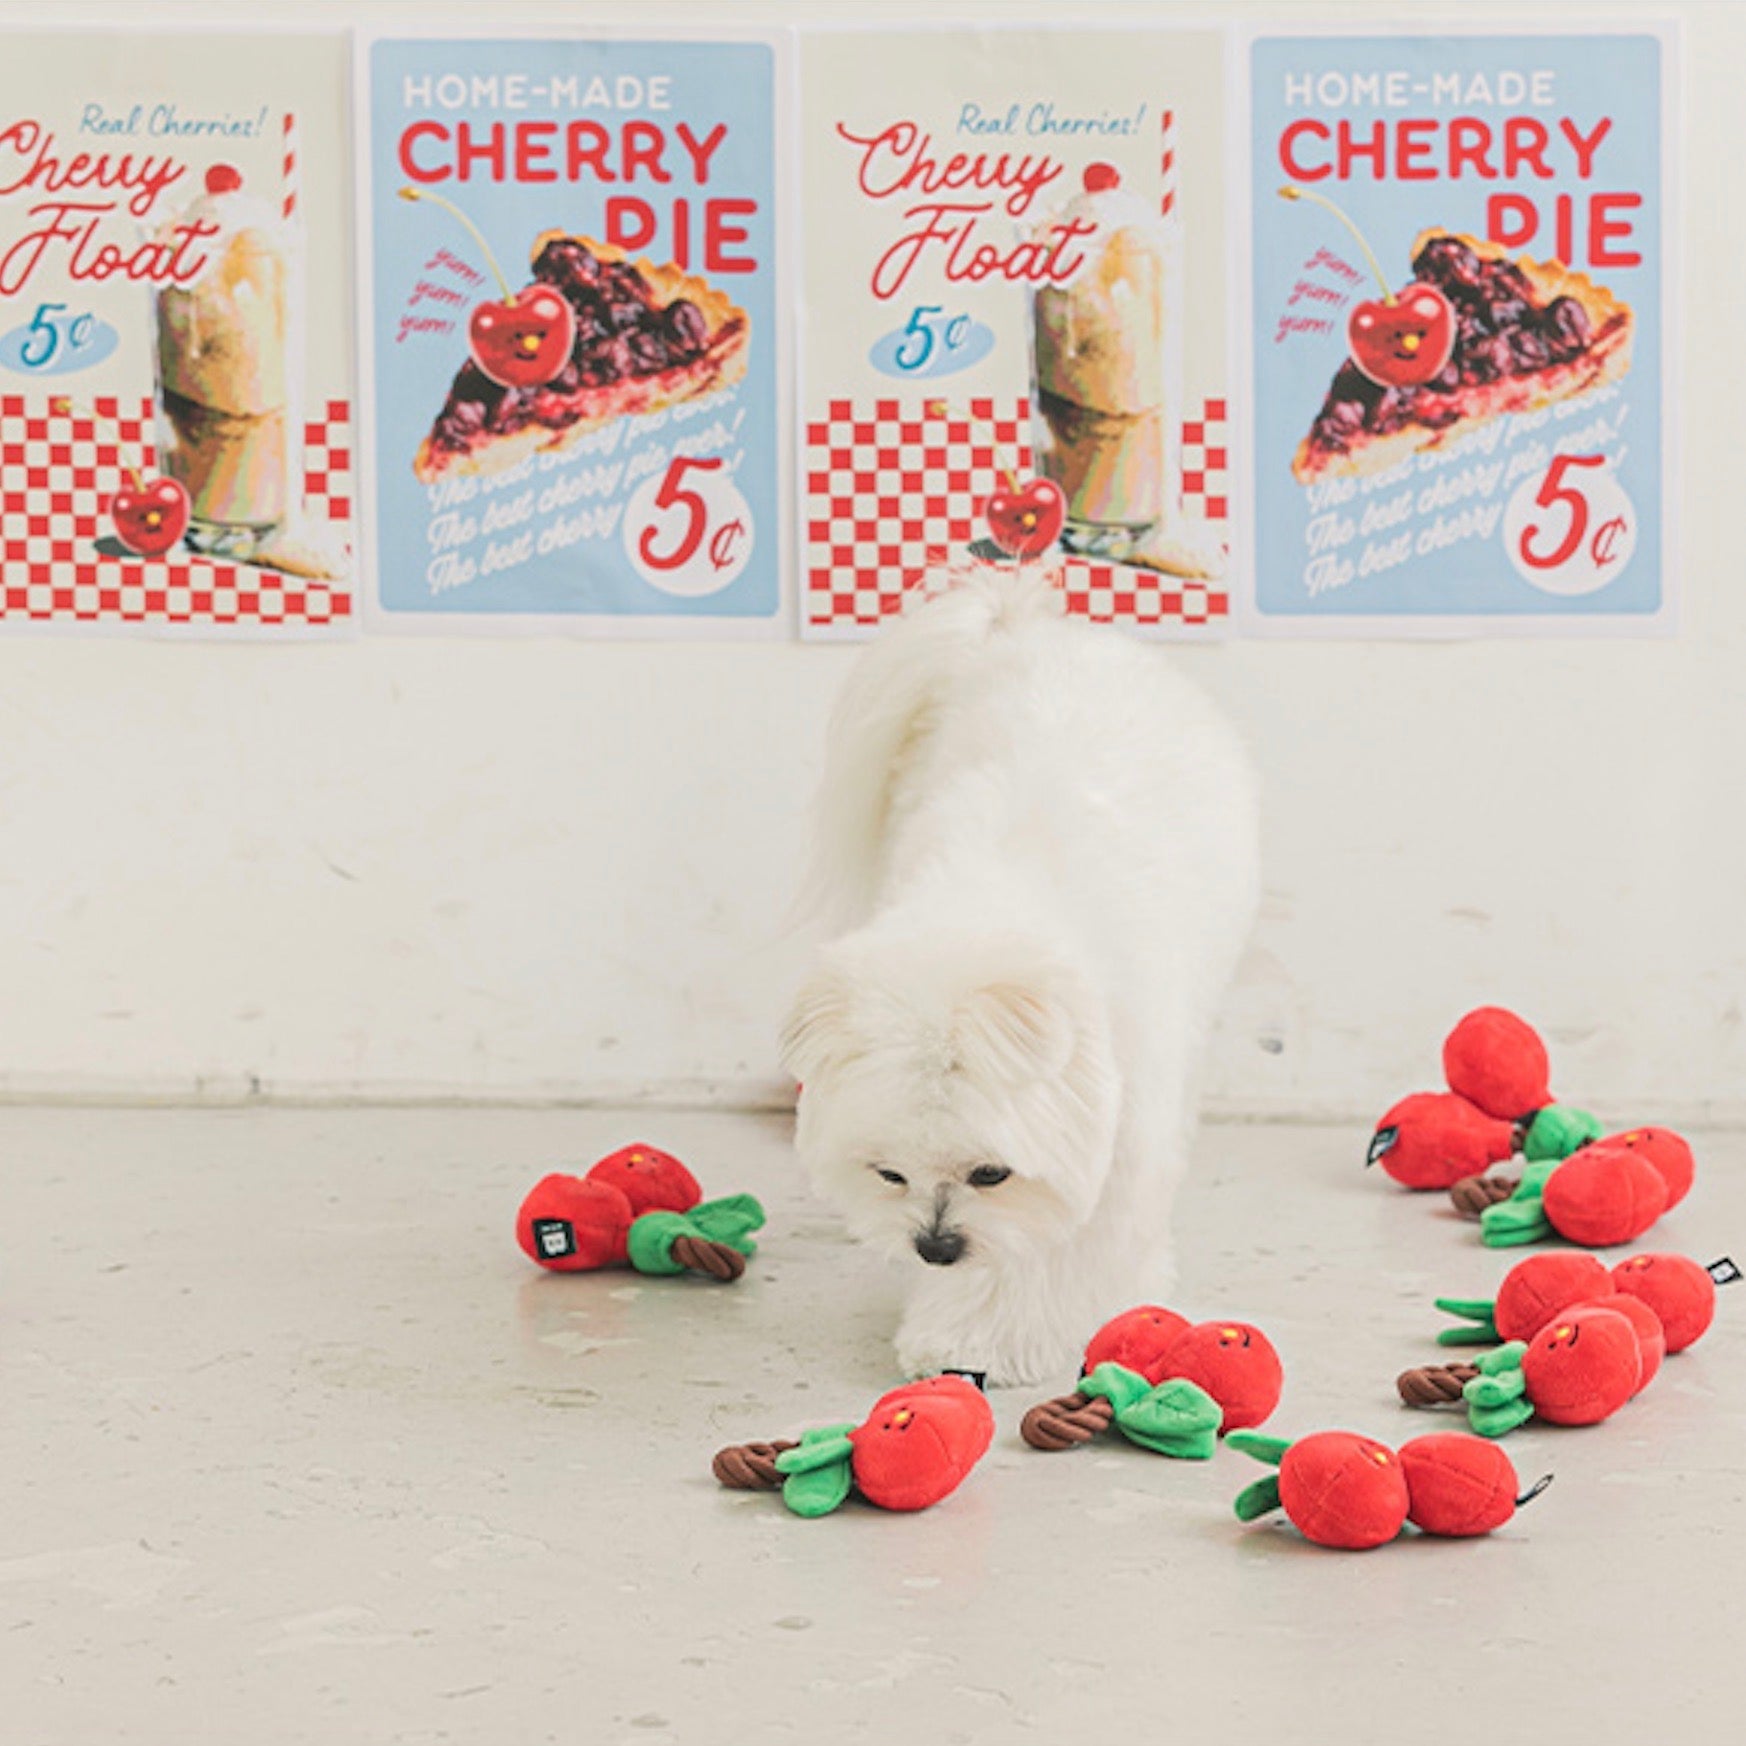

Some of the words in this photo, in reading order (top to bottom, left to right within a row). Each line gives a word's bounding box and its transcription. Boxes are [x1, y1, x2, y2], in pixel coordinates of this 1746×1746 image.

[78, 104, 141, 136] Real
[148, 105, 268, 137] Cherries!
[404, 74, 673, 111] HOME-MADE
[956, 103, 1020, 136] Real
[1026, 103, 1148, 136] Cherries!
[1284, 70, 1557, 107] HOME-MADE
[397, 119, 729, 185] CHERRY
[1277, 115, 1613, 182] CHERRY
[0, 203, 220, 296] Float
[605, 195, 758, 273] PIE
[870, 203, 1098, 300] Float
[1486, 191, 1643, 268] PIE
[425, 551, 477, 596] The
[479, 530, 533, 576] best
[536, 502, 624, 555] cherry
[427, 511, 477, 554] The
[481, 489, 534, 535] best
[537, 460, 624, 514] cherry
[639, 455, 746, 571] 5¢
[1303, 553, 1355, 598] The
[1358, 530, 1413, 578] best
[1415, 500, 1505, 556] cherry
[1305, 512, 1356, 556] The
[1360, 490, 1414, 536] best
[1416, 460, 1505, 514] cherry
[1519, 452, 1629, 568] 5¢
